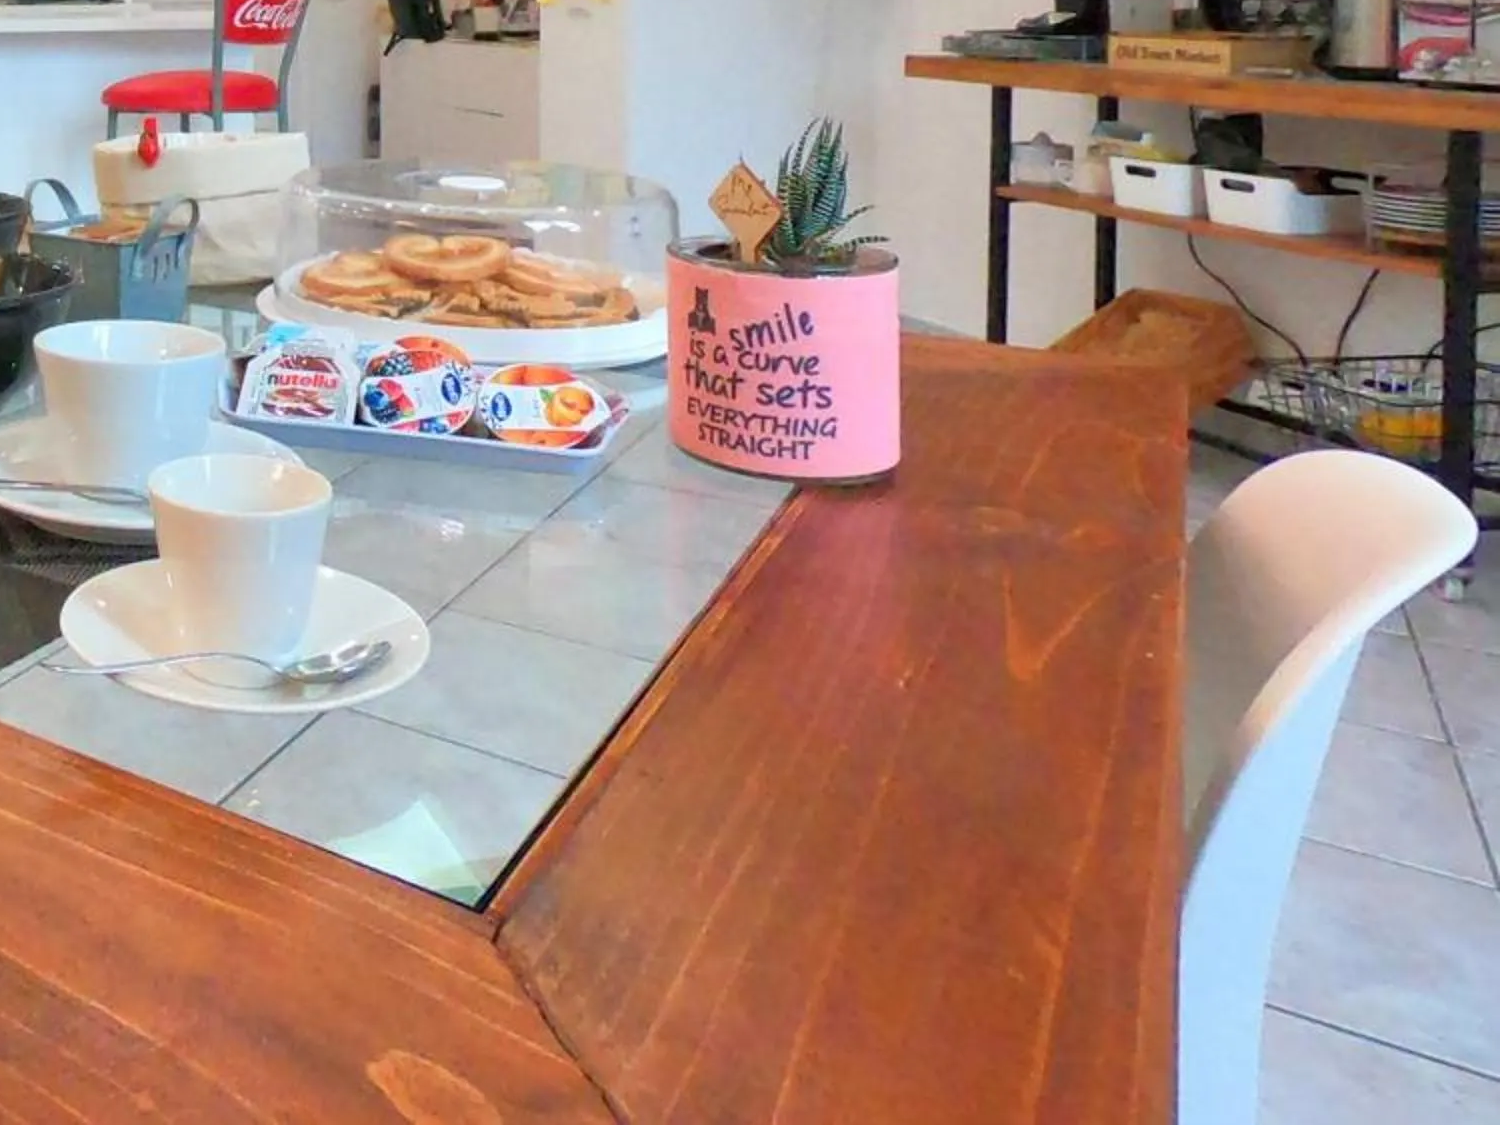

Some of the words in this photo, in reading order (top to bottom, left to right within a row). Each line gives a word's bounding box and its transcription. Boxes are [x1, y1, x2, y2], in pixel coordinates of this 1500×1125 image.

[728, 302, 816, 352] smile
[688, 331, 707, 360] is
[712, 345, 730, 367] a
[736, 350, 821, 376] curve
[267, 373, 339, 390] nutella
[683, 357, 745, 400] that
[755, 378, 834, 410] sets
[686, 396, 839, 439] EVERYTHING
[697, 423, 816, 461] STRAIGHT
